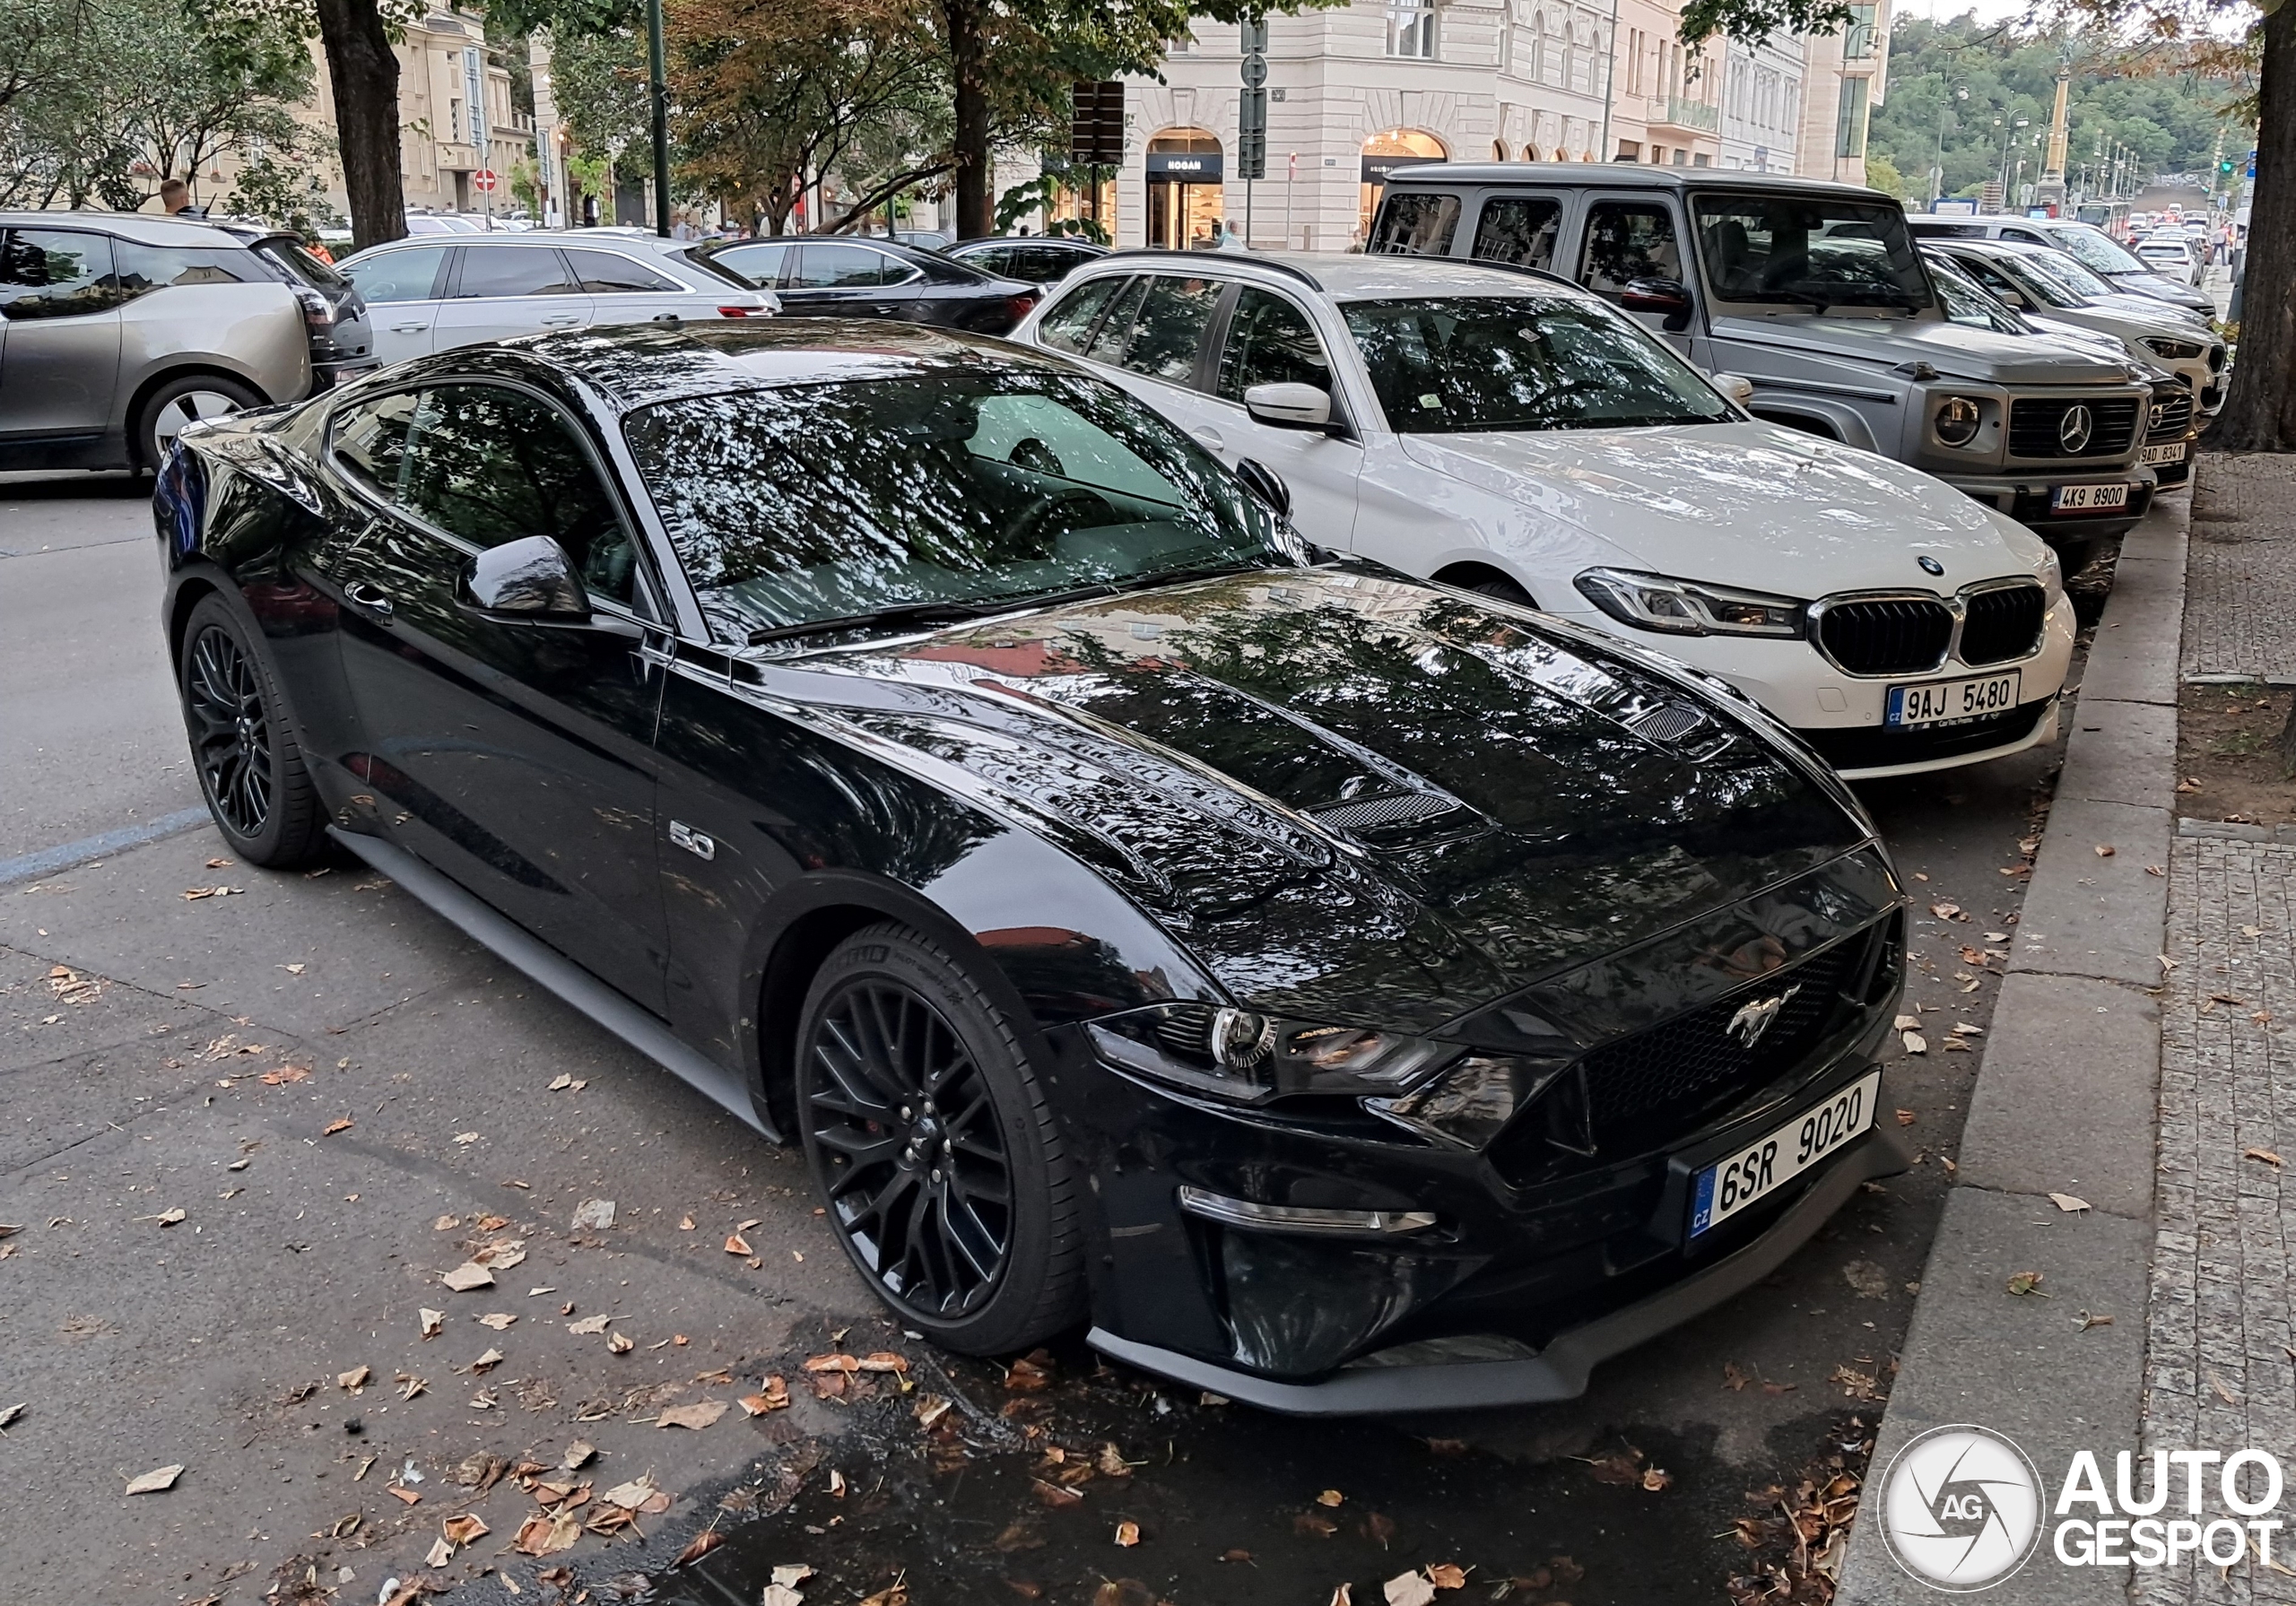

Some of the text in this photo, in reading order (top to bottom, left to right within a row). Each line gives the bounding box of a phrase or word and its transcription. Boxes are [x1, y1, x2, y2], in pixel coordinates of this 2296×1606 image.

[1168, 161, 1201, 169] HOGAN
[2141, 445, 2182, 463] 9AD 8341
[2062, 487, 2123, 507] 4K9 8900
[1908, 679, 2010, 720] 9AJ 5480
[1889, 712, 1901, 722] CZ
[669, 820, 715, 862] 5.0
[1720, 1086, 1862, 1212] 6SR 9020
[1692, 1209, 1709, 1228] CZ
